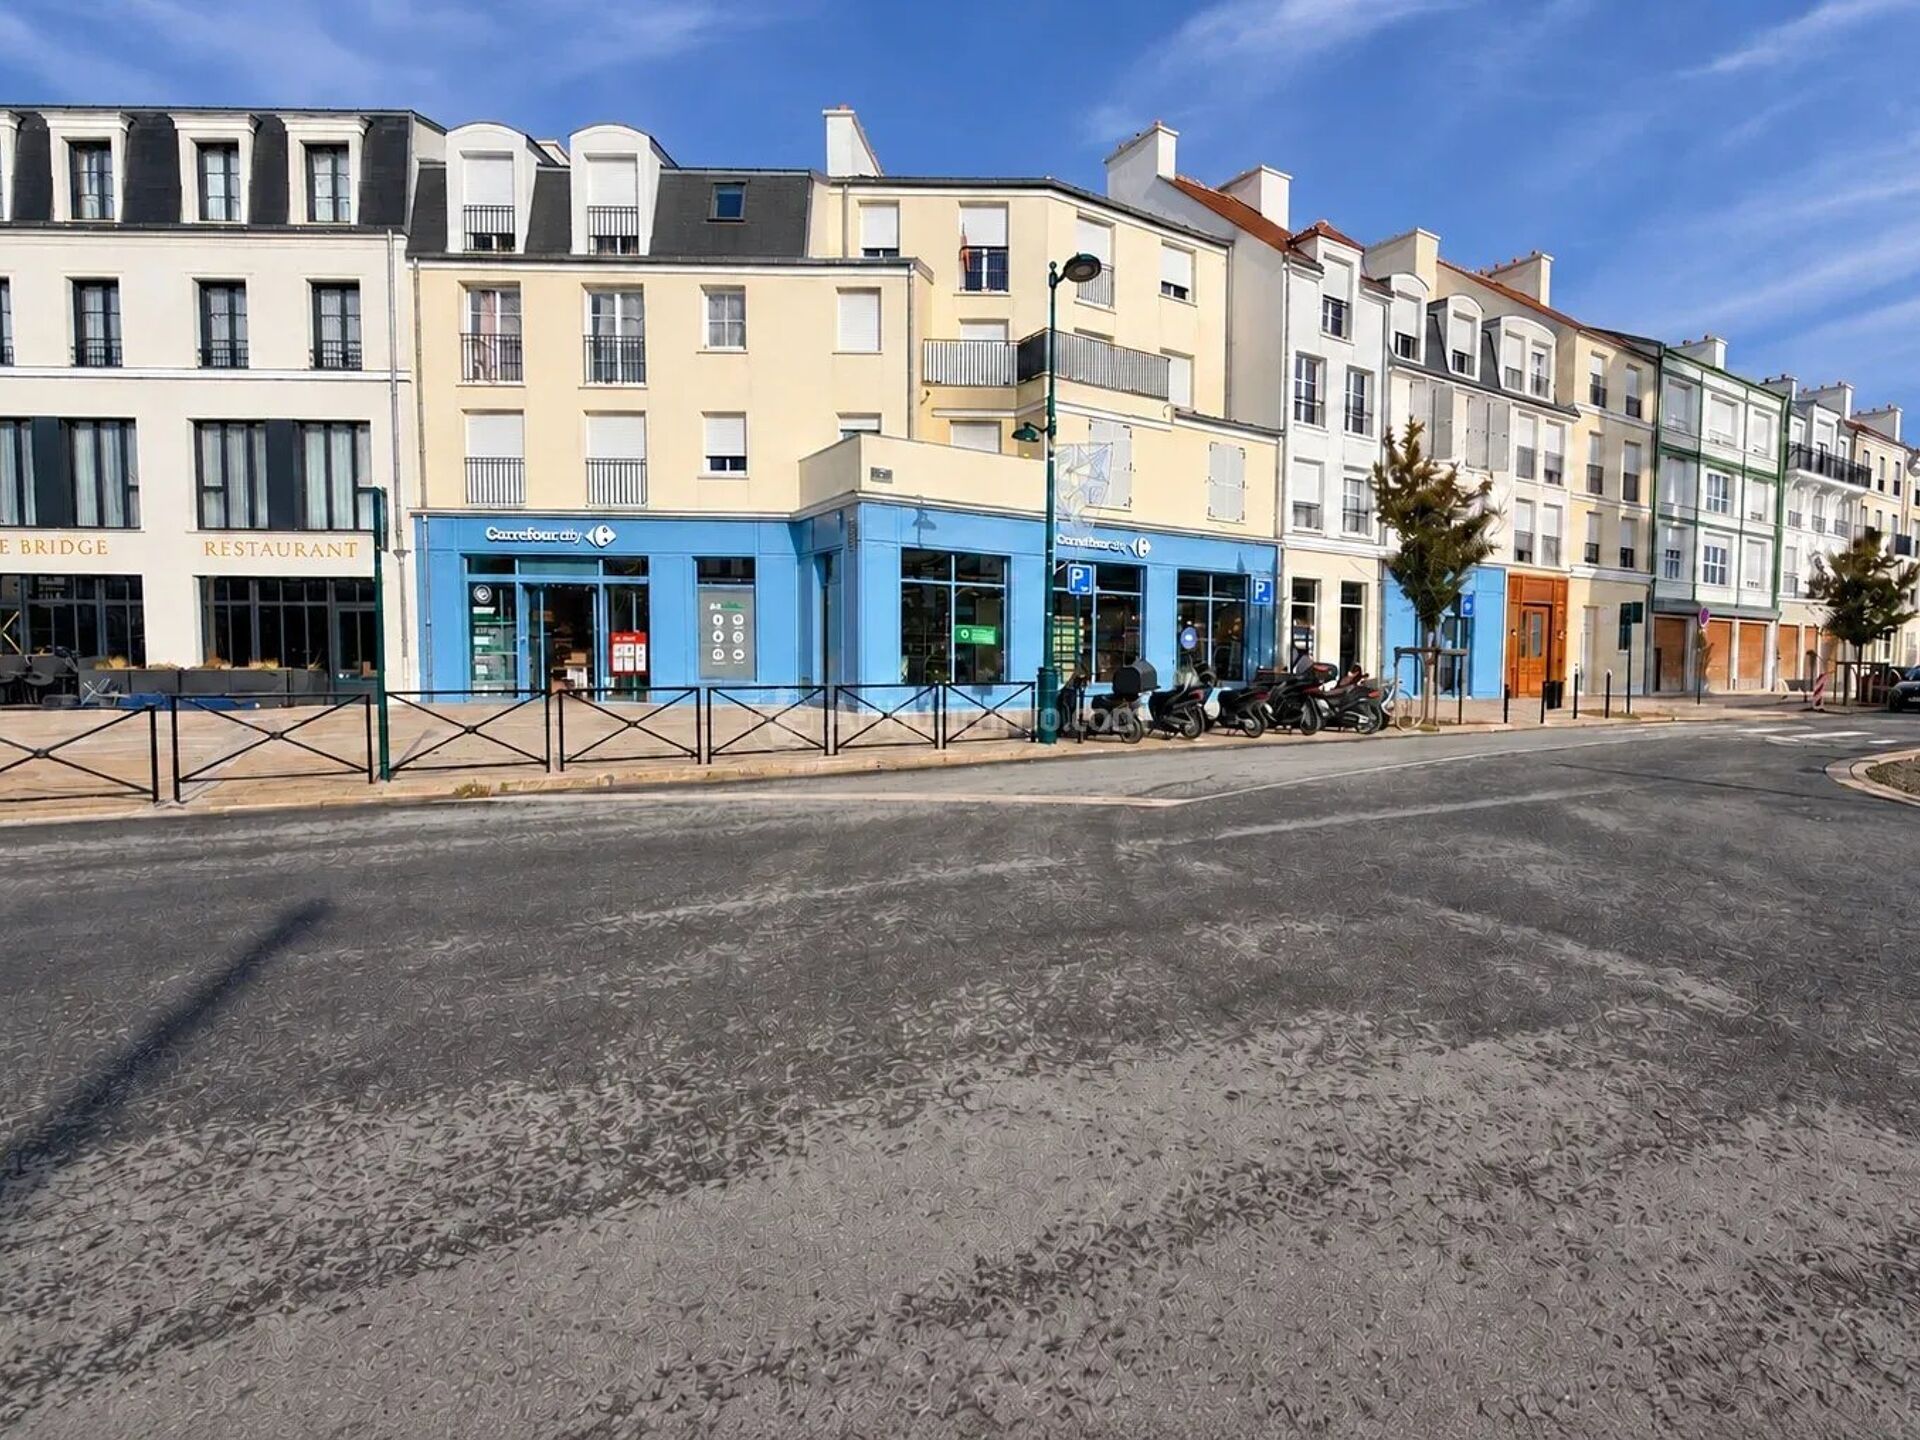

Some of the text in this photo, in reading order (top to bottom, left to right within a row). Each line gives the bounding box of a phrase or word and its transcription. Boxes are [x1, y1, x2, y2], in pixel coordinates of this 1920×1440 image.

[485, 526, 557, 541] Carrefour
[21, 539, 108, 555] BRIDGE
[205, 541, 358, 557] RESTAURANT
[1072, 568, 1083, 589] P
[1255, 582, 1265, 600] P
